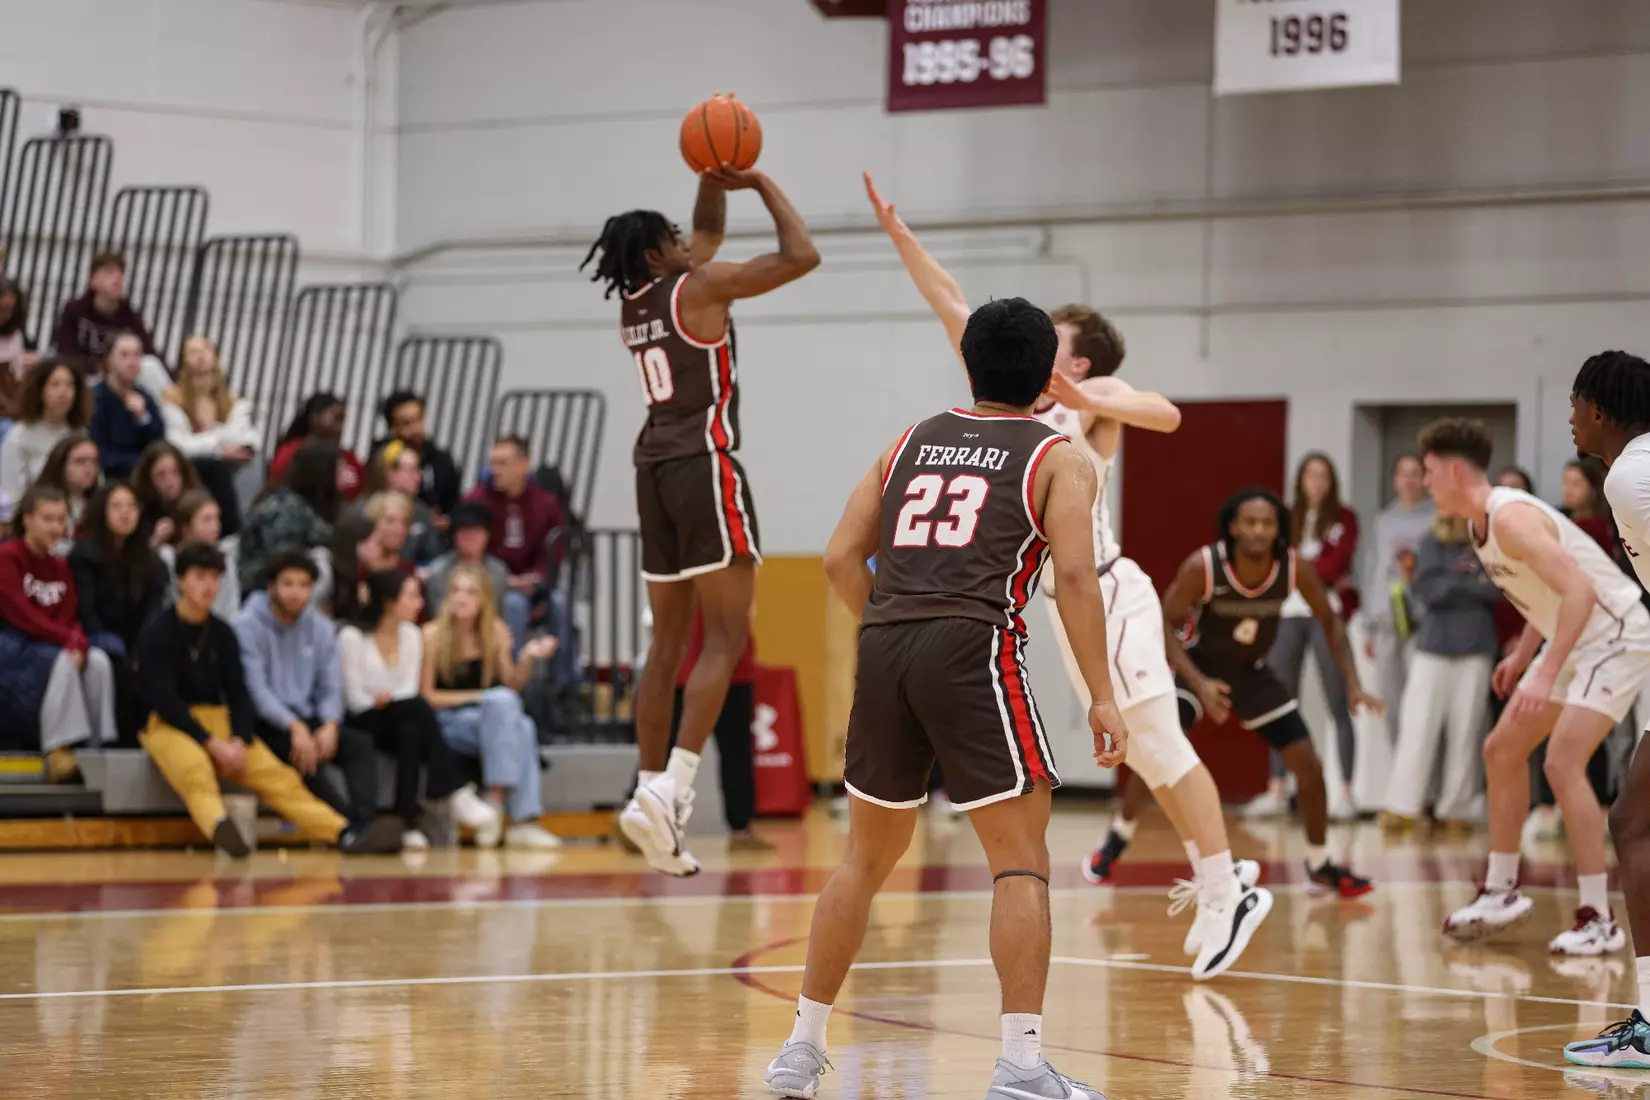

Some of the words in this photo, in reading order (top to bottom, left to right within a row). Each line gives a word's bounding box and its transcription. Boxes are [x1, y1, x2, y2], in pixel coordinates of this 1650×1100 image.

[904, 1, 1031, 33] CHAMPIONS
[1269, 12, 1349, 57] 1996
[902, 34, 1035, 86] 1995-96
[914, 445, 1010, 471] FERRARI
[892, 472, 991, 548] 23
